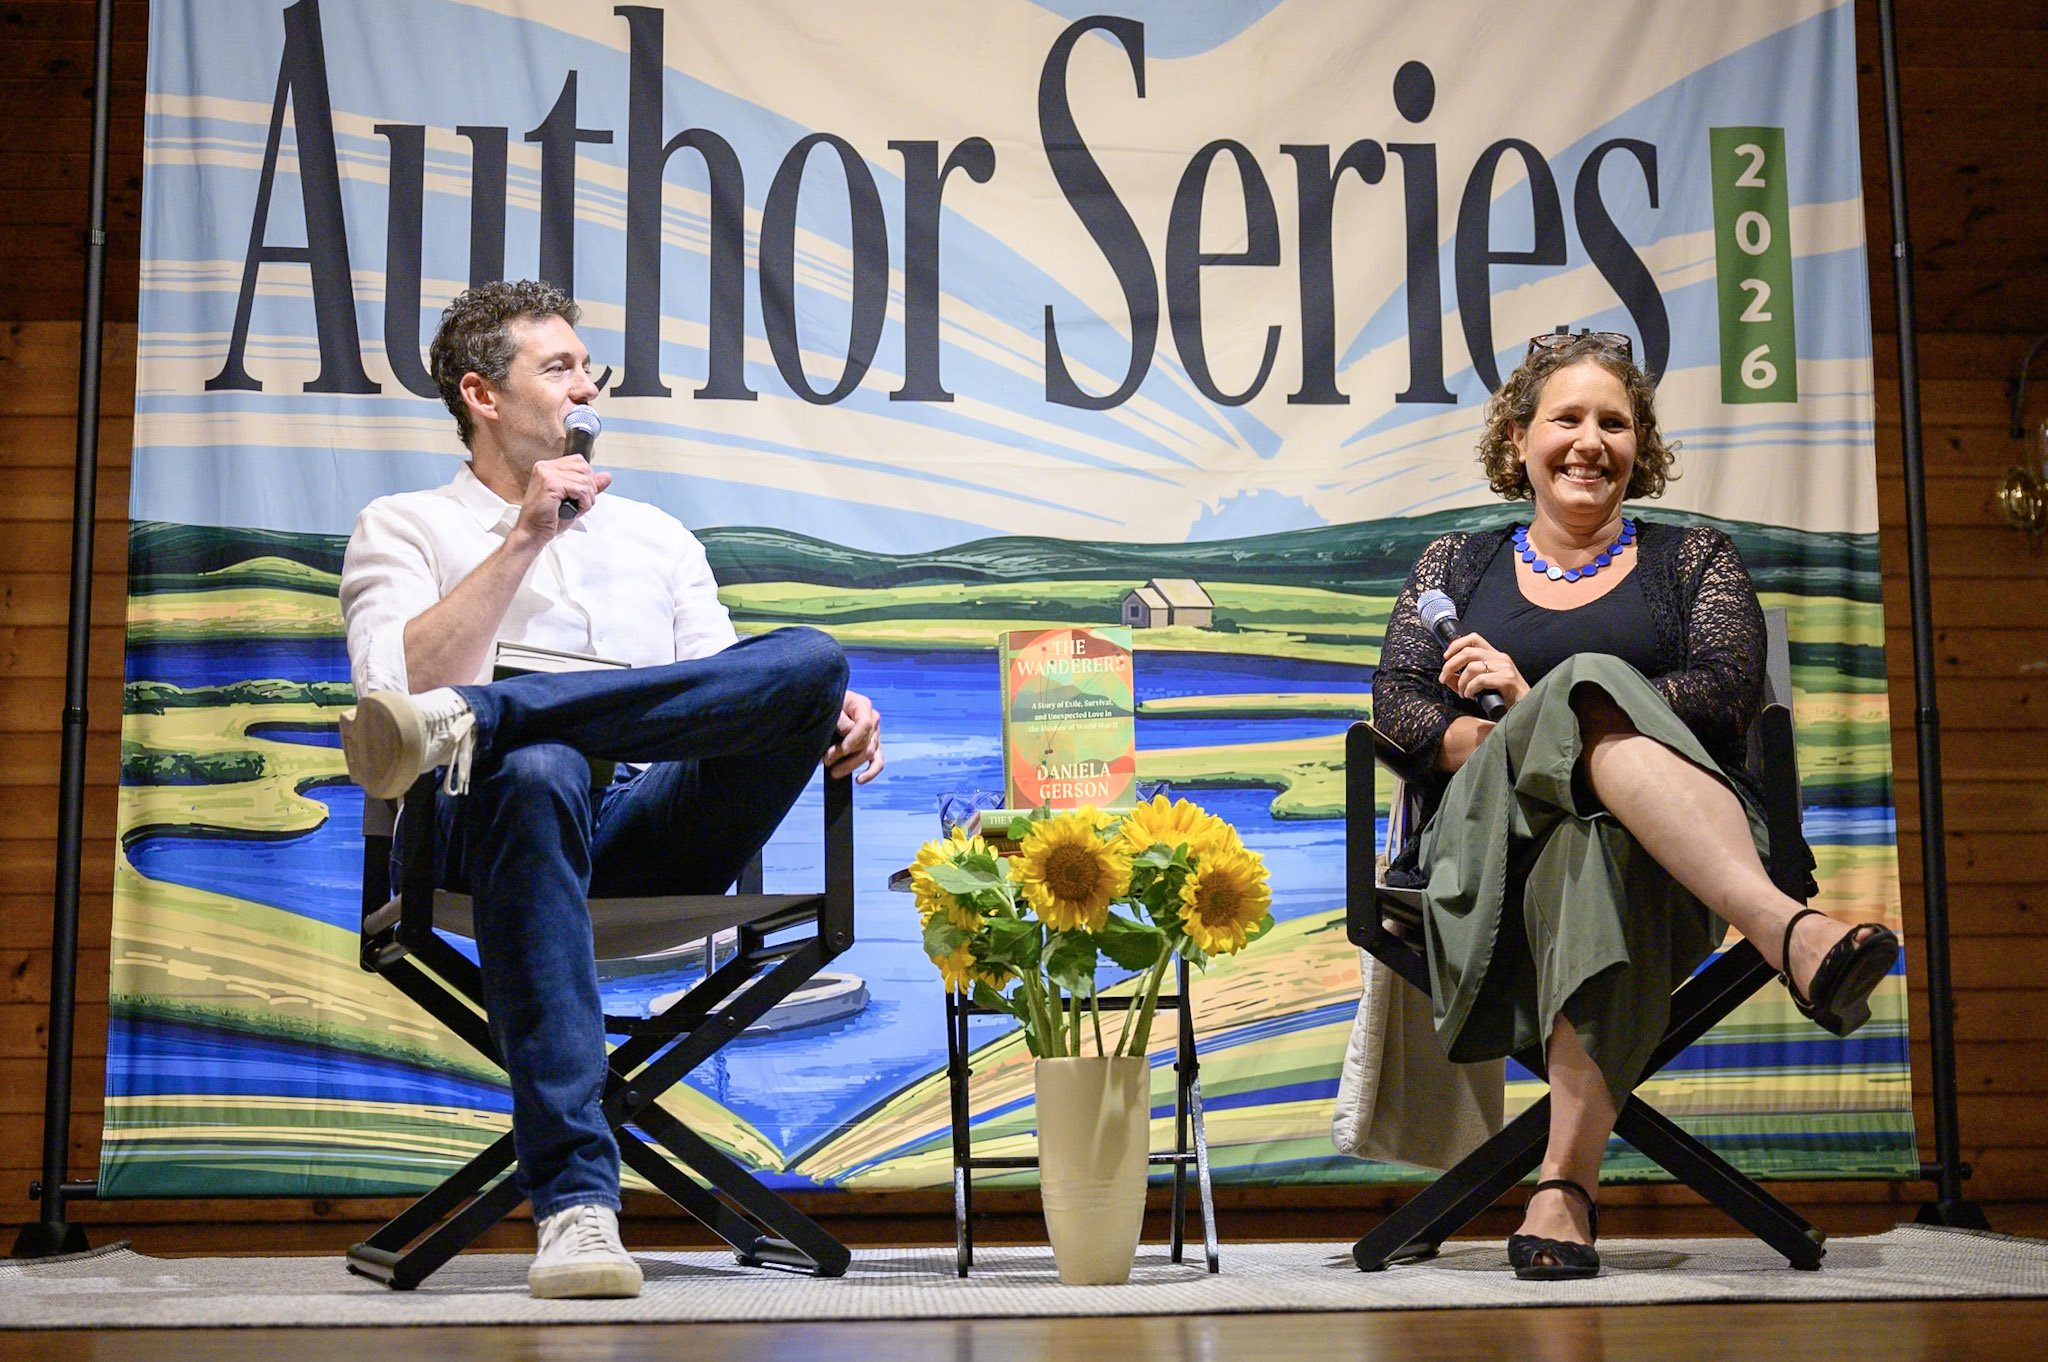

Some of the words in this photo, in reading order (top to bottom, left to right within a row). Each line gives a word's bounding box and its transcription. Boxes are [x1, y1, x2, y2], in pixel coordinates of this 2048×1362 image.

[205, 0, 996, 406] Author
[1038, 15, 1670, 411] Series
[1732, 143, 1778, 390] 2026
[1052, 639, 1086, 656] THE
[1017, 654, 1125, 677] WANDERERS
[1031, 702, 1037, 710] A
[1037, 702, 1055, 711] Story
[1056, 700, 1064, 709] of
[1065, 700, 1084, 709] Exile,
[1084, 698, 1114, 707] Survival,
[1034, 713, 1047, 721] and
[1048, 711, 1087, 721] Unexpected
[1088, 710, 1104, 718] Love
[1104, 709, 1112, 717] in
[1037, 762, 1111, 781] DANIELA
[1040, 781, 1109, 800] GERSON
[989, 815, 1006, 825] THE
